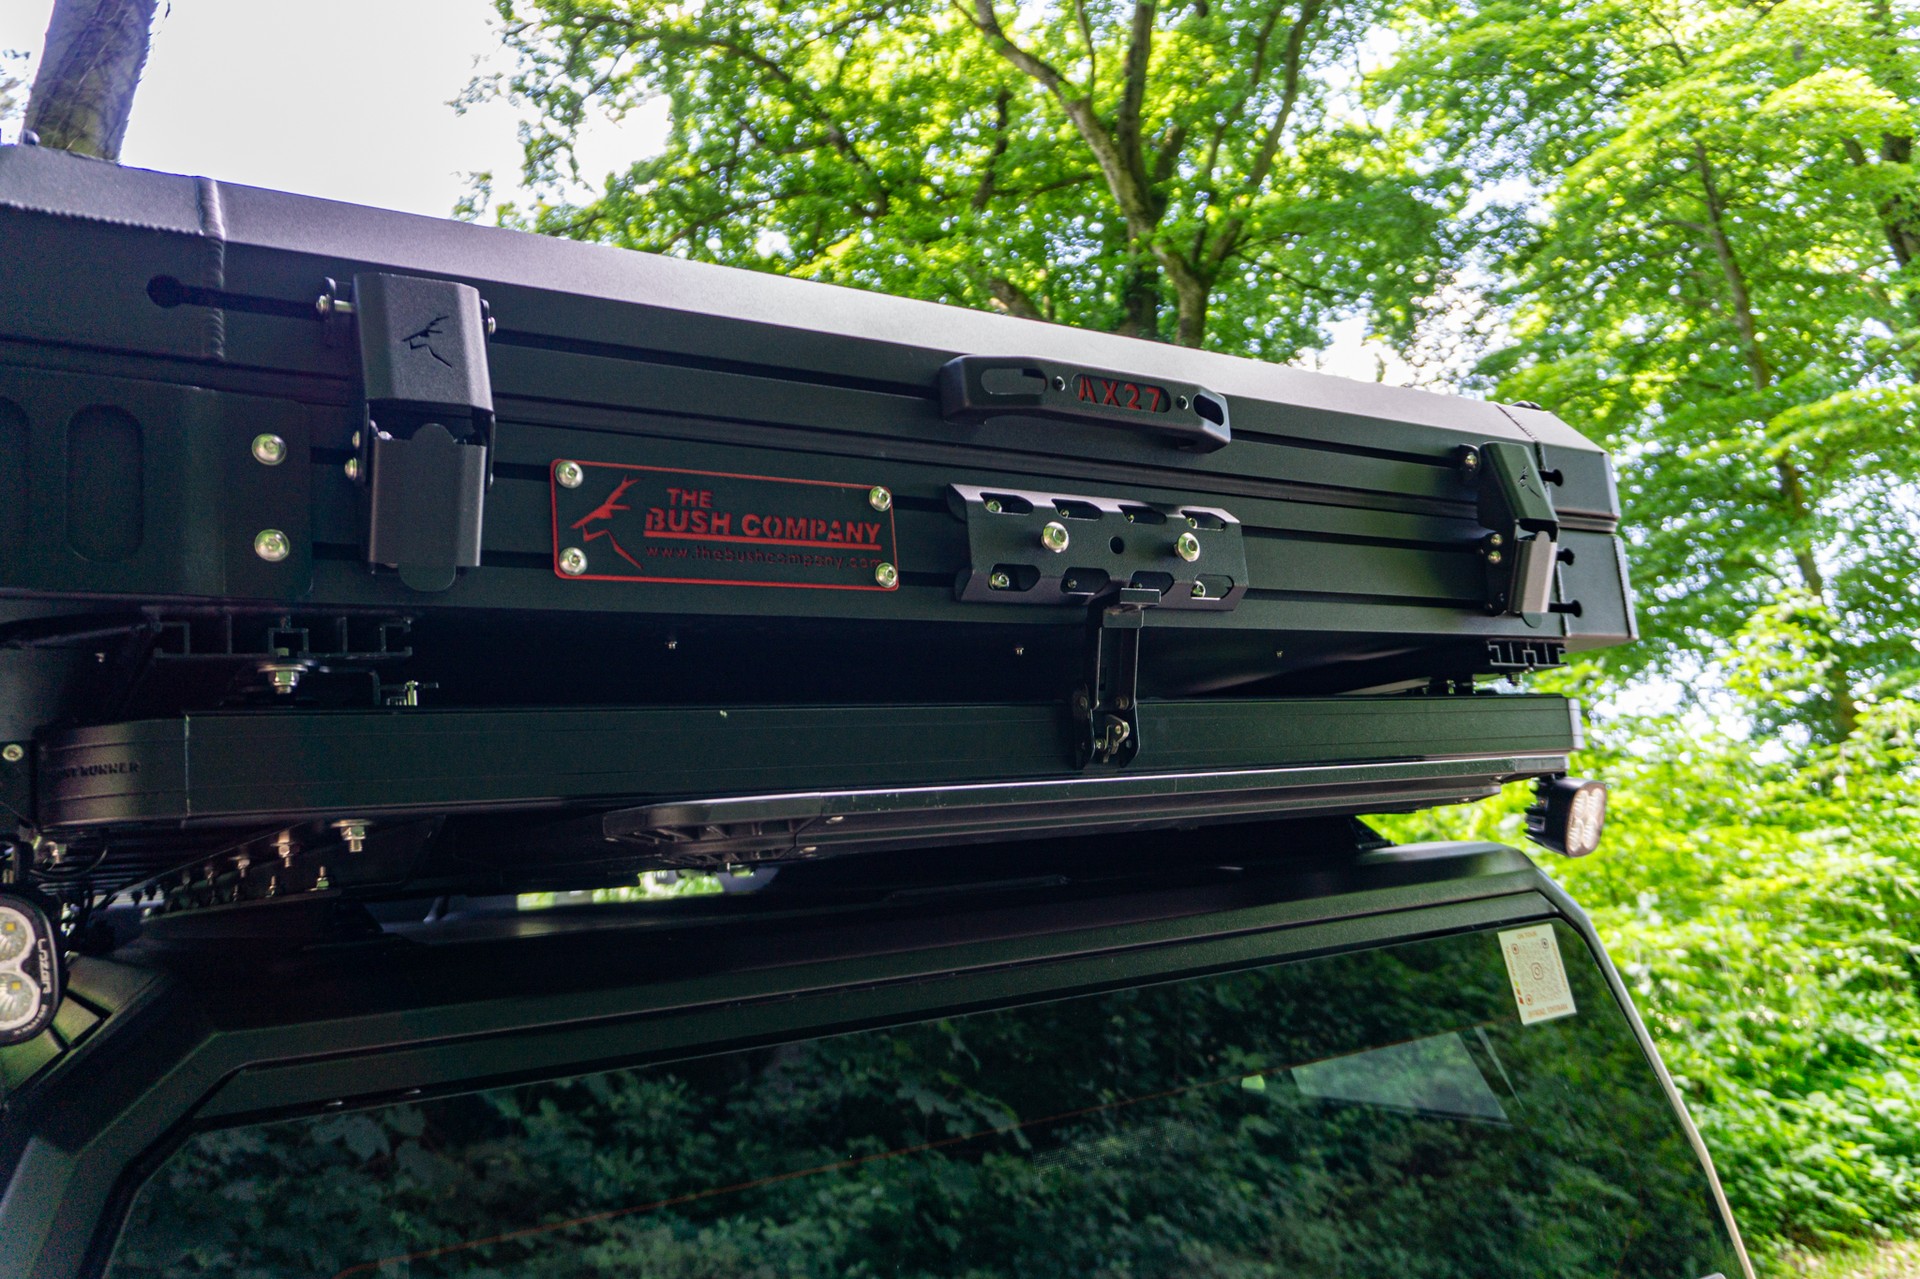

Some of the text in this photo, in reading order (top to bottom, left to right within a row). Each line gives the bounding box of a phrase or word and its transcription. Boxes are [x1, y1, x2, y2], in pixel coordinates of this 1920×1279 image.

[1078, 376, 1161, 412] AX27
[667, 488, 713, 508] THE
[646, 508, 881, 544] BUSH COMPANY
[646, 545, 883, 570] www.thebushcompany.com
